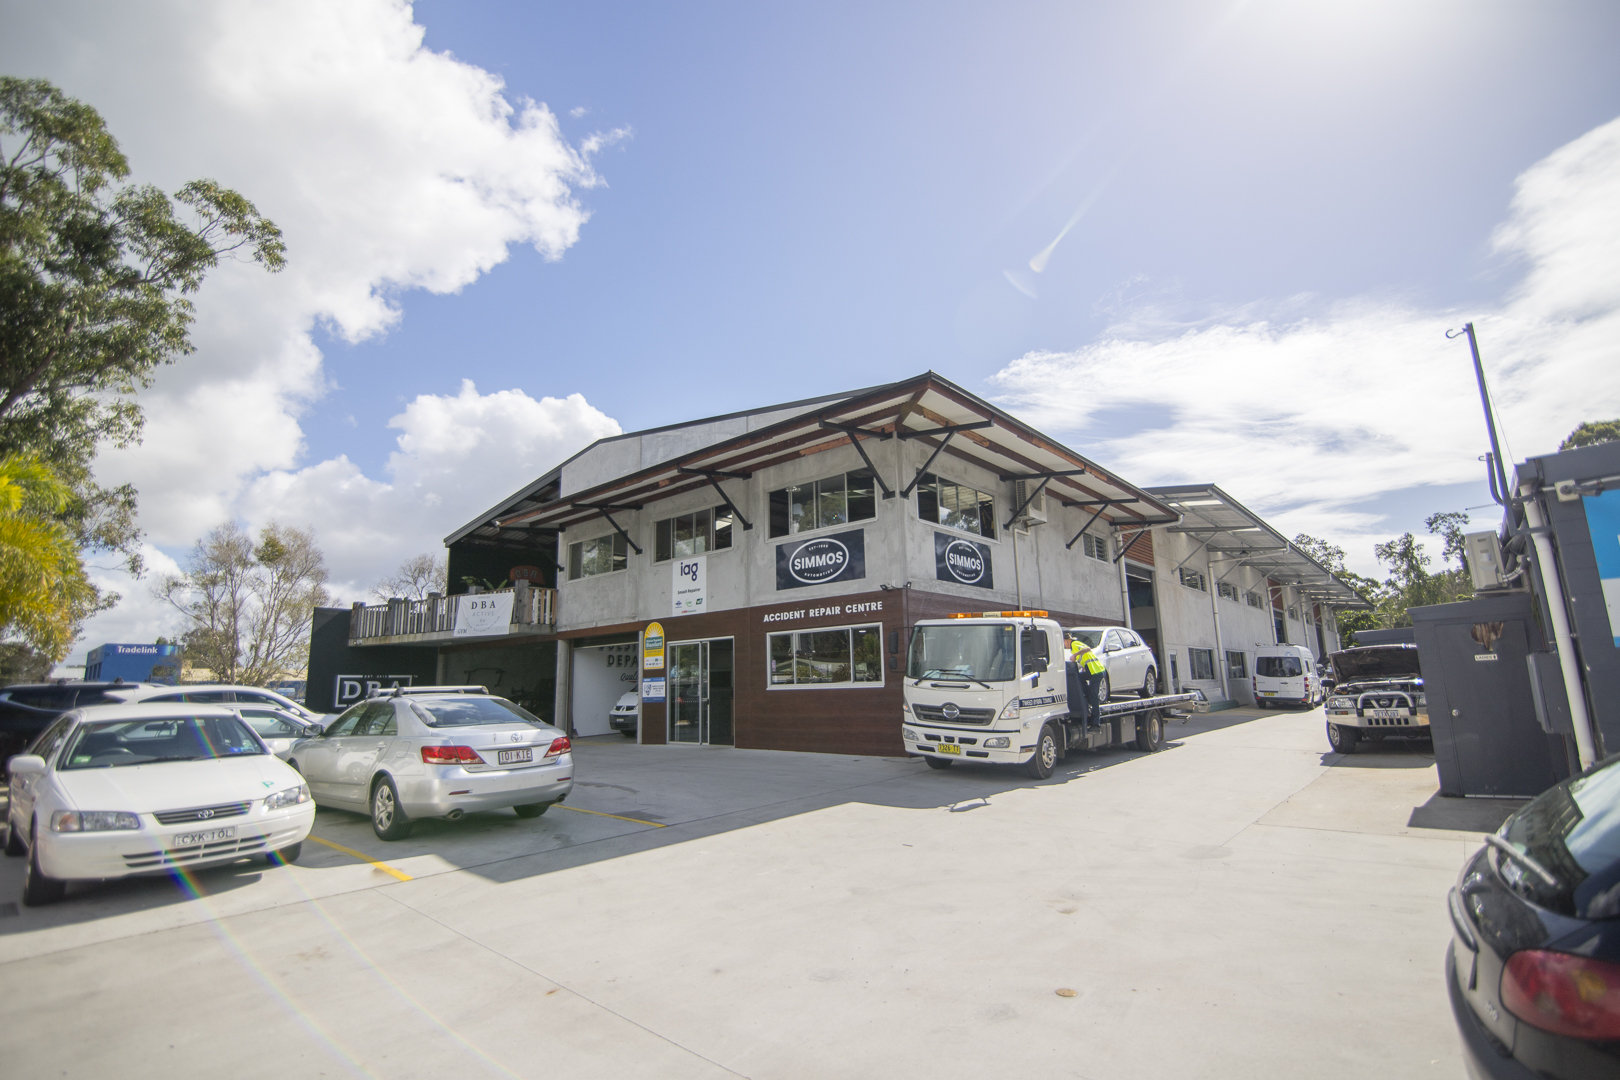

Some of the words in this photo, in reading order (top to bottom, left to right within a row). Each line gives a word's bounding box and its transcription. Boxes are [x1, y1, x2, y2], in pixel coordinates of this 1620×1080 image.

[793, 551, 844, 571] SIMMOS
[949, 552, 981, 571] SIMMOS
[680, 562, 699, 581] iag
[804, 568, 833, 577] AUTOMOTIVE
[471, 600, 496, 610] DBA
[763, 610, 806, 623] ACCIDENT
[809, 606, 841, 618] REPAIR
[845, 601, 883, 613] CENTRE
[117, 645, 158, 654] Tradelink
